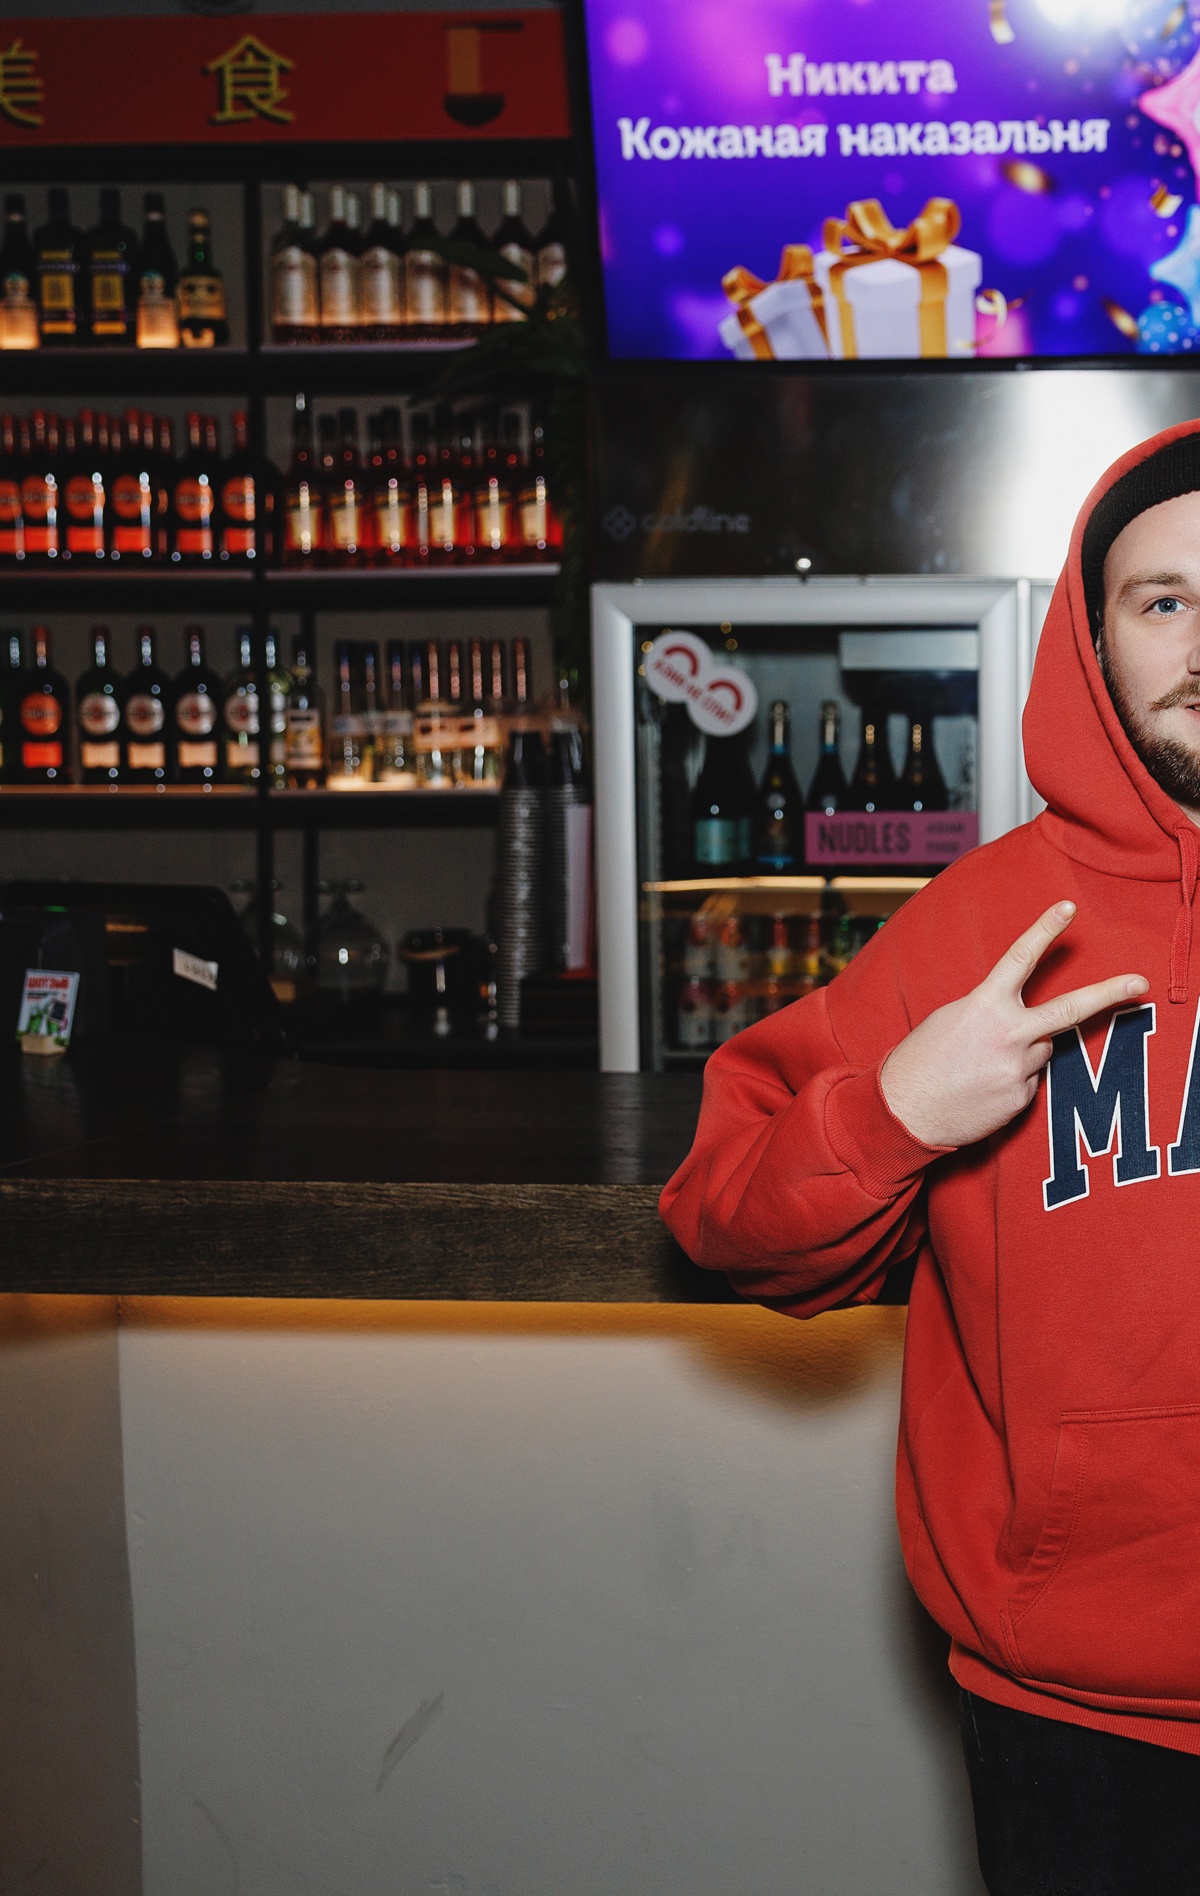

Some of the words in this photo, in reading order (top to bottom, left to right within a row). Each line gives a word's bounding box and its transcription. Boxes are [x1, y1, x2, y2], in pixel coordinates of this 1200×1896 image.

[764, 53, 957, 97] Никита
[617, 116, 828, 160] Кожаная
[837, 118, 1110, 157] наказальня
[817, 822, 911, 853] NUDLES
